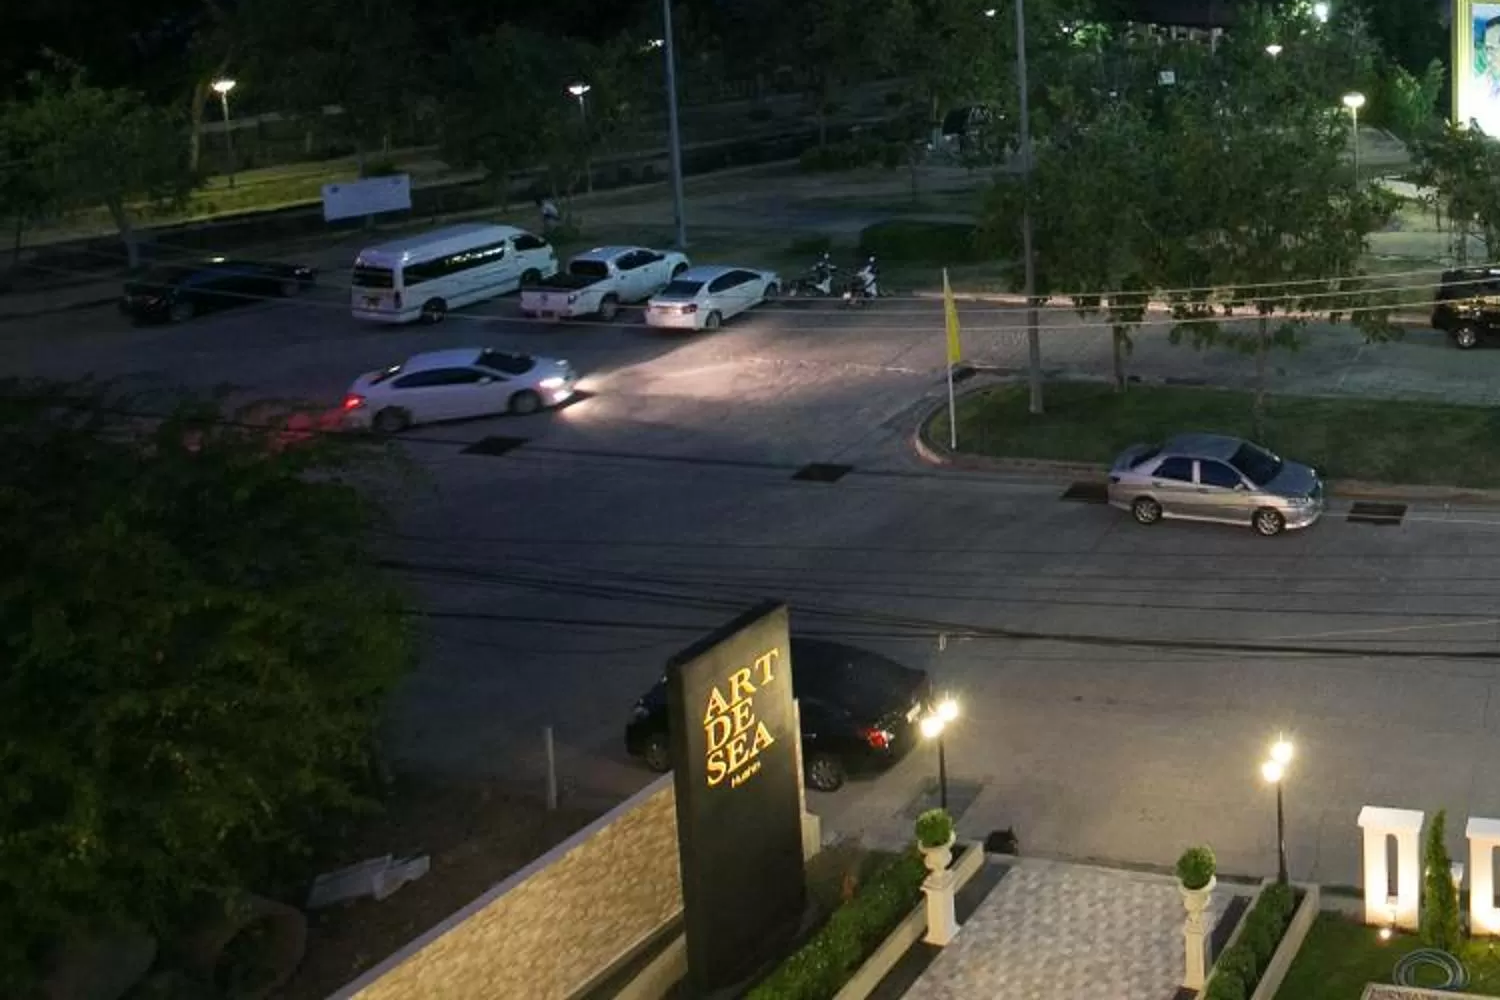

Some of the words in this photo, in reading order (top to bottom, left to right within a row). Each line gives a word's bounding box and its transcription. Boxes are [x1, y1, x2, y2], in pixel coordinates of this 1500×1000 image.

[704, 648, 779, 725] ART
[704, 697, 755, 754] DE
[707, 721, 775, 786] SEA
